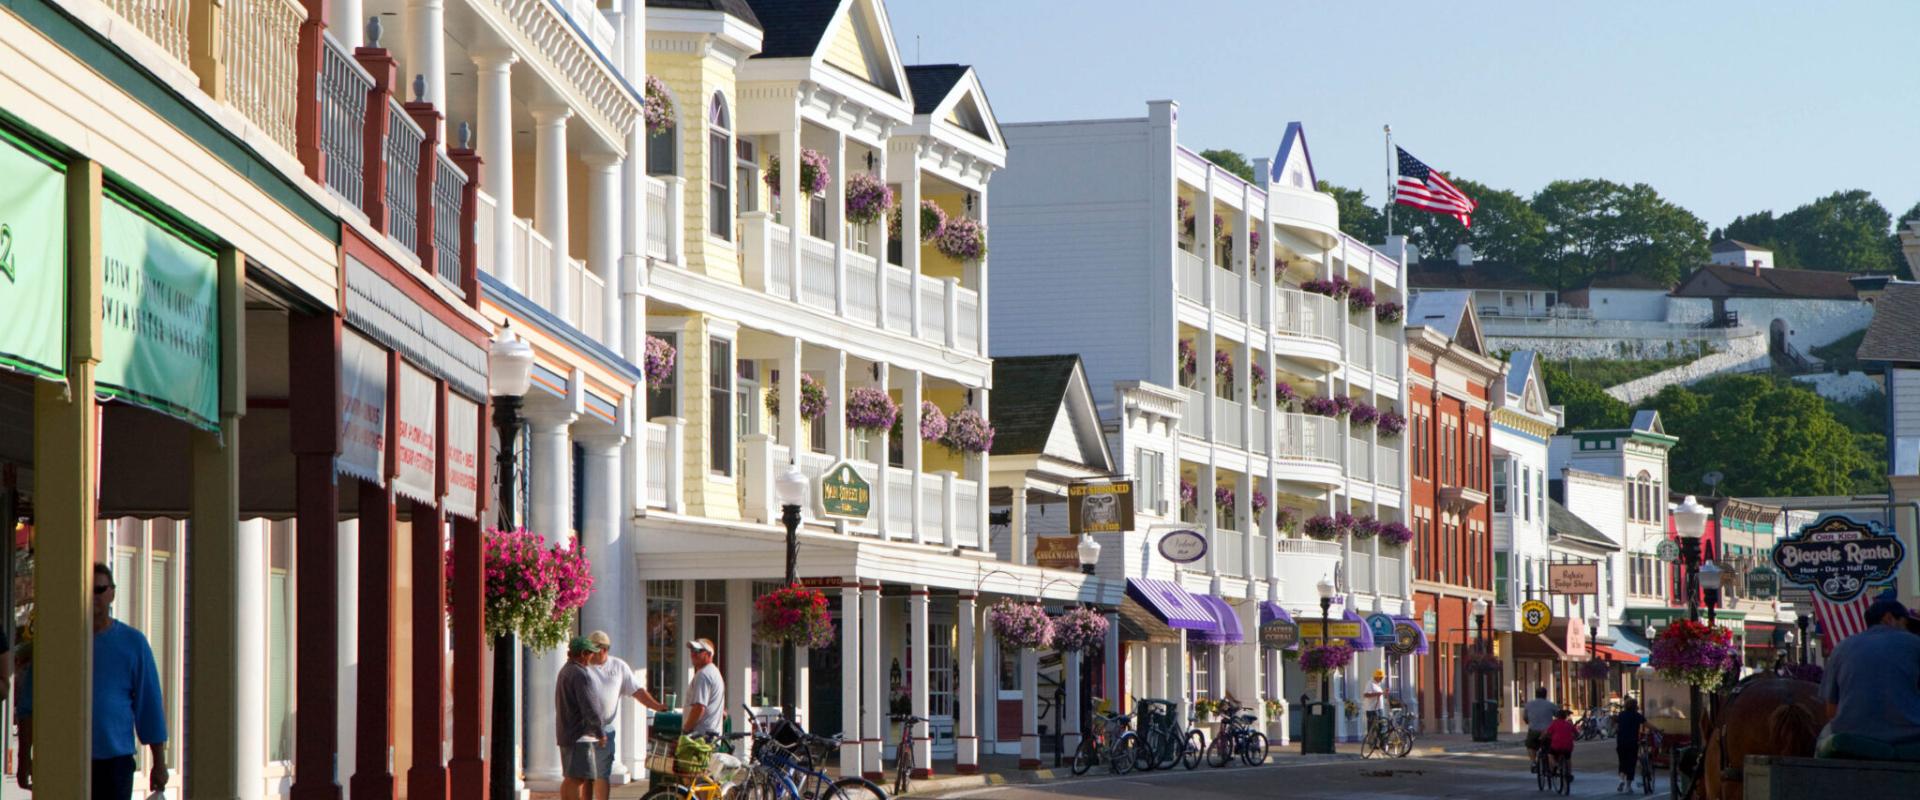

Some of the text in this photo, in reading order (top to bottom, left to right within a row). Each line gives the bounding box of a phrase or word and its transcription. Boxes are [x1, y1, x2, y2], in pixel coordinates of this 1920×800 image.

[1782, 542, 1895, 567] Bicycle Rental
[1825, 566, 1838, 574] Day
[1864, 564, 1877, 572] Day
